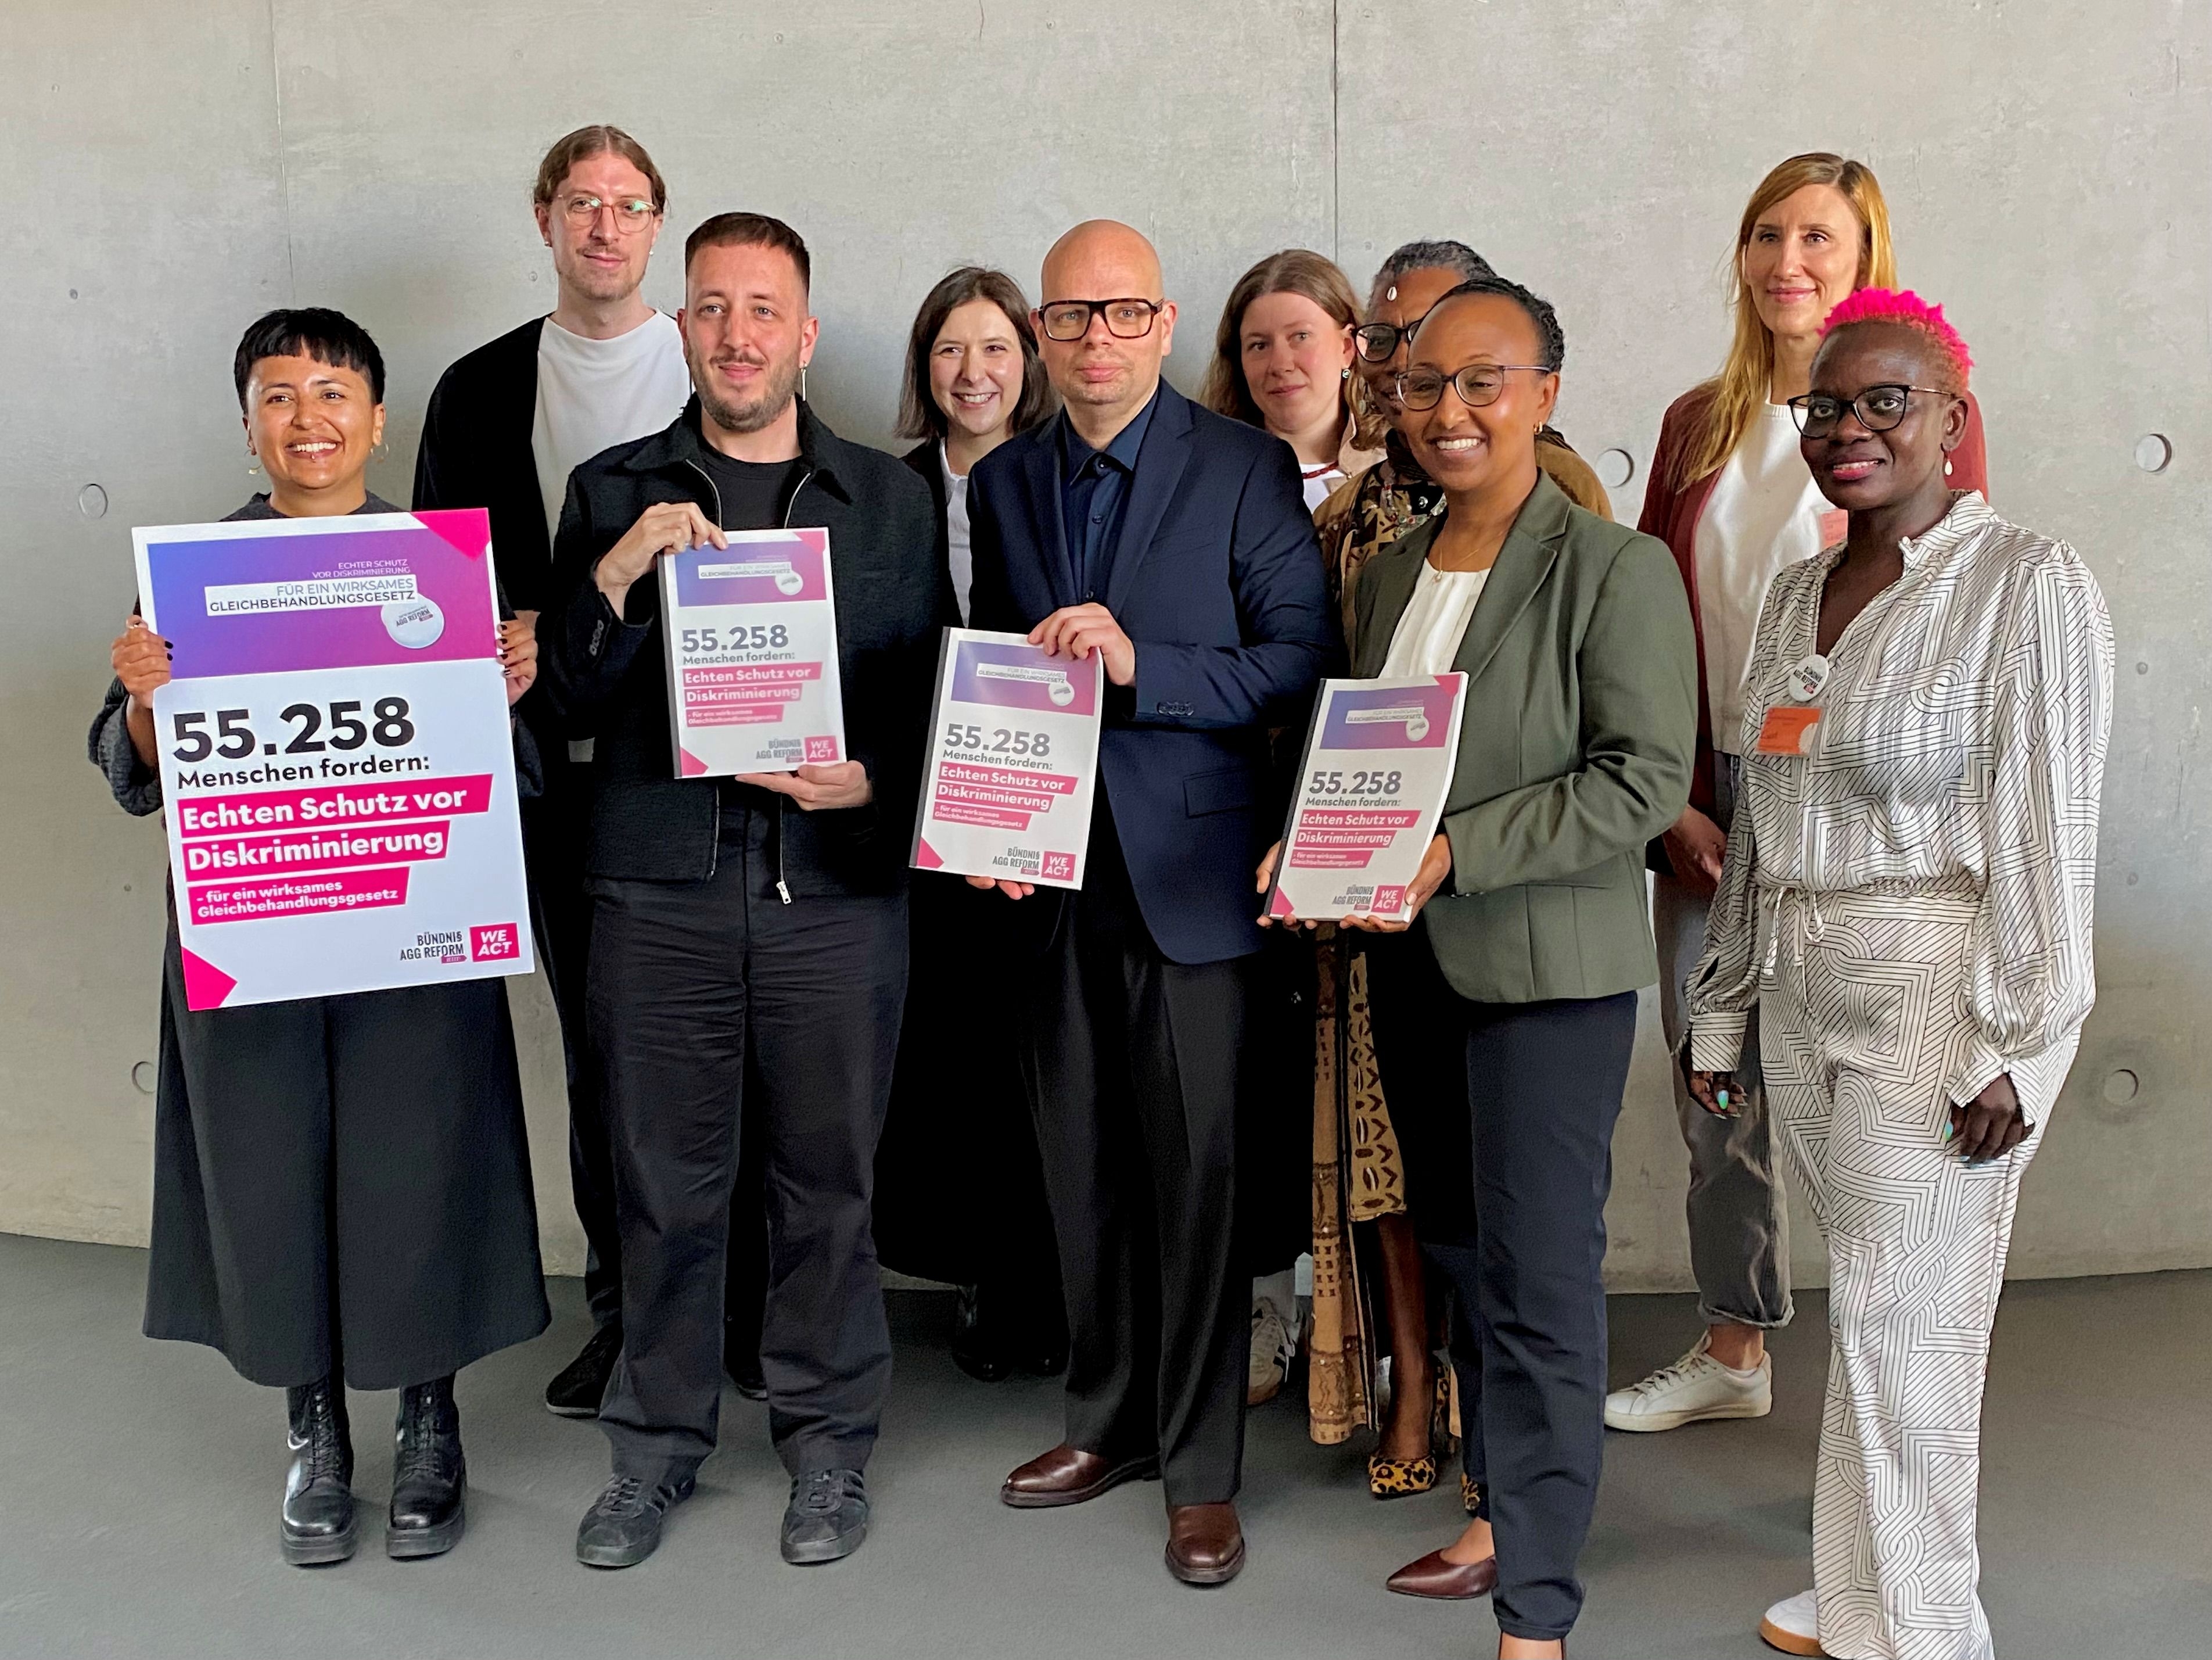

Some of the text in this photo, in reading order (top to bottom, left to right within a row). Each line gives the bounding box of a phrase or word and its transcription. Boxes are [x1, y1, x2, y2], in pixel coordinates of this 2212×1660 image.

[338, 558, 408, 570] ECHTER SCHUTZ
[312, 567, 411, 579] VOR DISKRIMINIERUNG
[276, 578, 414, 596] FÜR EIN WIRKSAMES
[210, 590, 415, 612] GLEICHBEHANDLUNGSGESETZ
[681, 625, 789, 652] 55.258
[683, 651, 795, 665] Menschen fordern:
[685, 668, 811, 683] Echten Schutz vor
[686, 686, 800, 703] Diskriminierung
[174, 697, 415, 762] 55.258
[810, 740, 829, 750] WE
[944, 723, 1051, 756] 55.258
[943, 749, 1053, 770] Menschen fordern:
[177, 755, 430, 789] Menschen fordern:
[940, 766, 1065, 790] Echten Schutz vor
[1309, 770, 1402, 794] 55.258
[938, 784, 1050, 811] Diskriminierung
[1305, 797, 1402, 806] Menschen fordern:
[184, 788, 468, 830] Echten Schutz vor
[1301, 812, 1409, 825] Echten Schutz vor
[1297, 831, 1392, 846] Diskriminierung
[188, 829, 444, 871] Diskriminierung
[992, 856, 1040, 870] AGG REFORM
[1049, 855, 1069, 867] WE
[206, 888, 229, 904] für
[232, 885, 256, 901] ein
[258, 879, 343, 897] wirksames
[1381, 890, 1399, 899] WE
[198, 887, 398, 918] Gleichbehandlungsgesetz
[480, 930, 507, 943] WE
[400, 944, 464, 960] AGG REFORM
